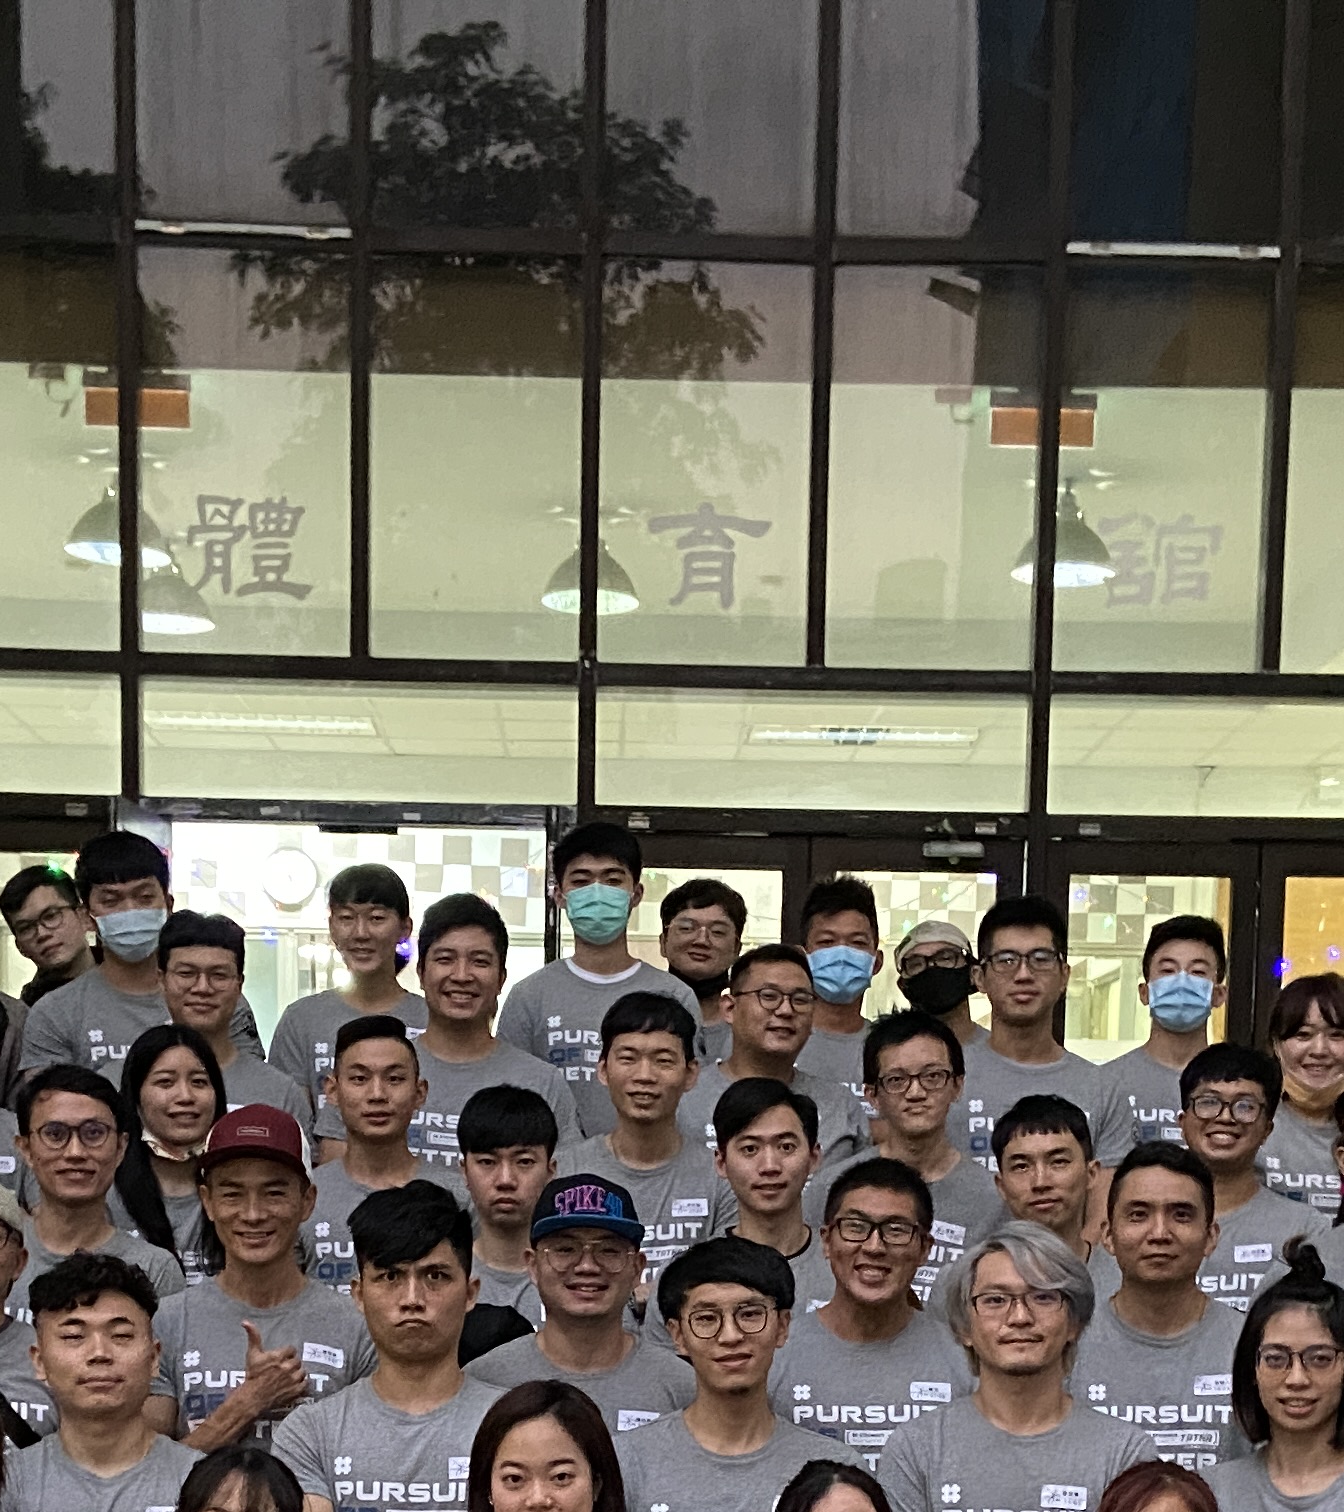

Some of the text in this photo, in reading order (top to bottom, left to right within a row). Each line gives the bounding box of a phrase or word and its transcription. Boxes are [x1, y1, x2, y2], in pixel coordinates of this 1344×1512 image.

[1266, 1173, 1341, 1188] PURS
[793, 1404, 938, 1424] PURSUI
[1093, 1404, 1233, 1424] URSUIT
[334, 1481, 467, 1503] PURSUI
